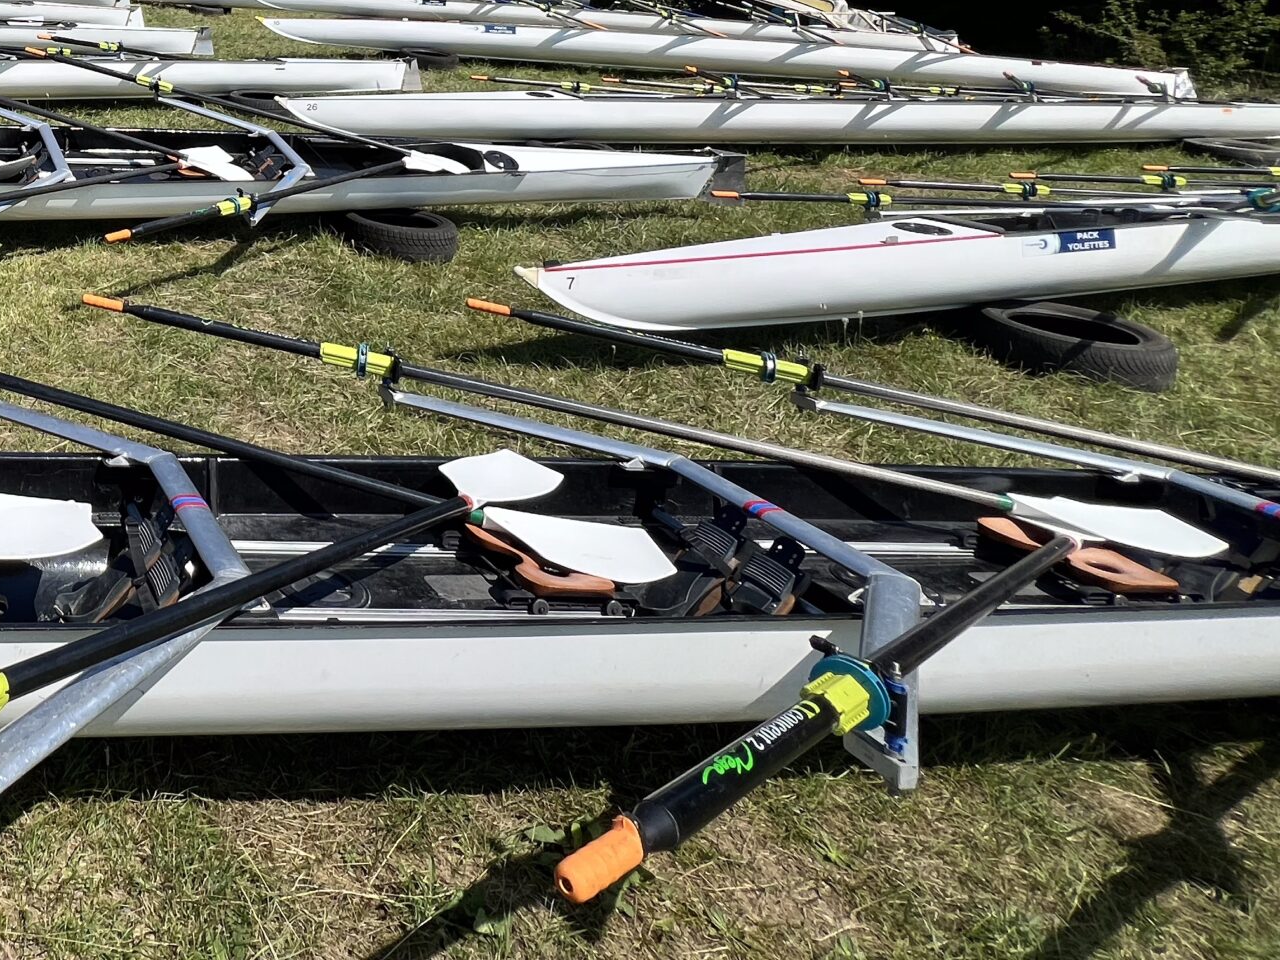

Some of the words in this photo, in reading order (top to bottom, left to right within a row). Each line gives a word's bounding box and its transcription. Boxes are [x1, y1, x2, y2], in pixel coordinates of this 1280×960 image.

[307, 103, 318, 111] 26
[1076, 231, 1100, 240] PACK
[1067, 241, 1110, 251] YOLETTES
[566, 276, 575, 290] 7
[756, 709, 804, 745] concept
[745, 737, 765, 751] 2
